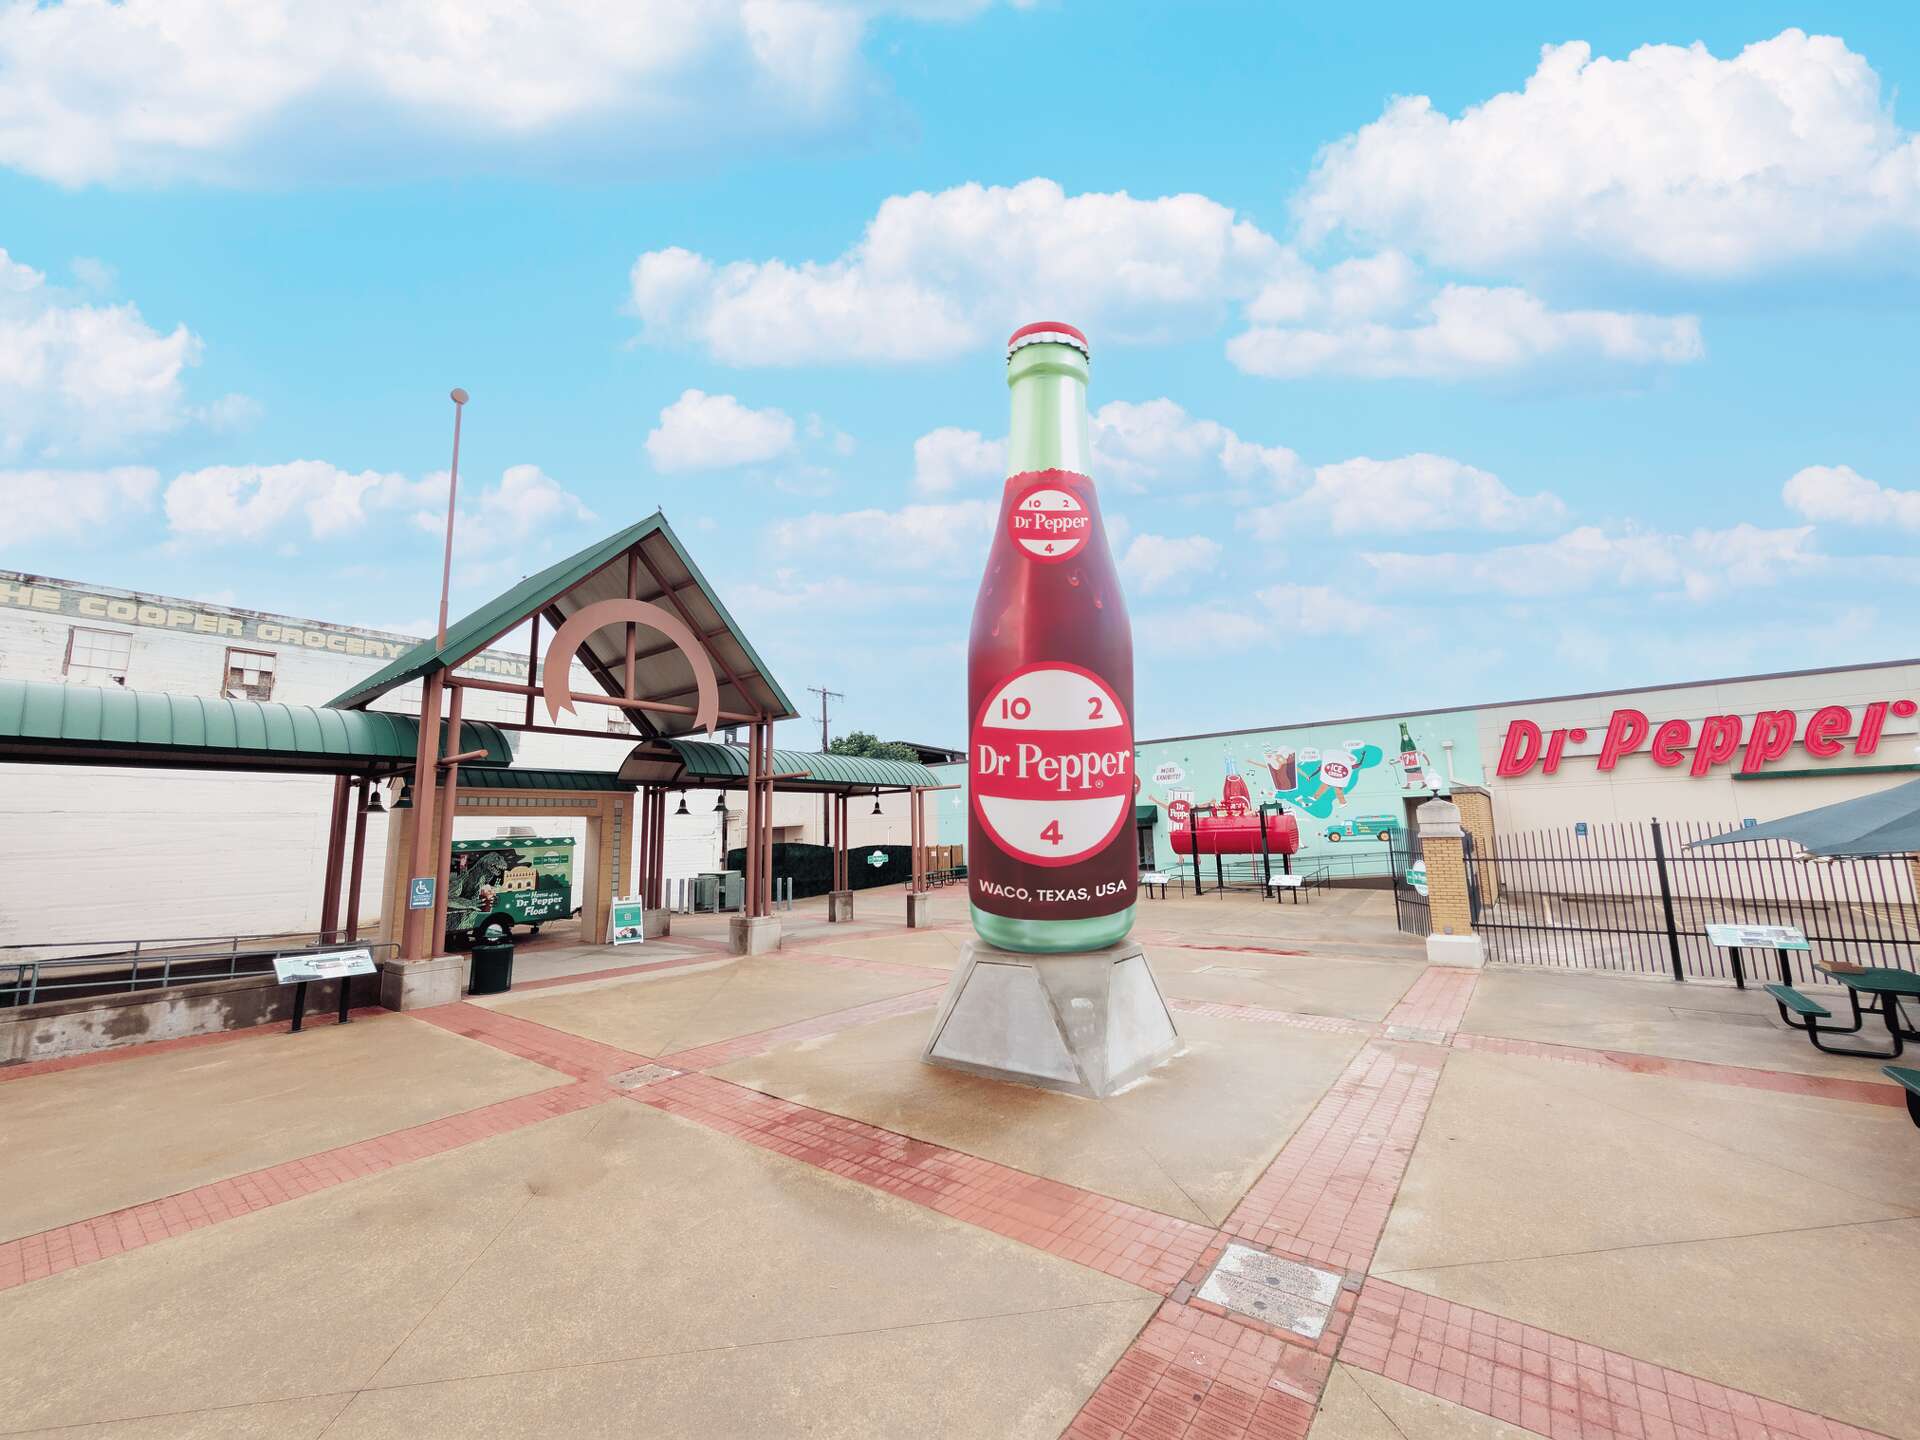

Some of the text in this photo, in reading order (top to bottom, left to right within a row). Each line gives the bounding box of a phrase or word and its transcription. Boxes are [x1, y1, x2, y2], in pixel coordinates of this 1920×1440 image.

[1028, 499, 1070, 508] 10 2
[1014, 513, 1089, 534] Dr Pepper
[1044, 543, 1054, 554] 4
[79, 597, 243, 636] COOPER
[257, 624, 405, 658] GROCERY
[1001, 696, 1104, 720] 10 2
[1496, 699, 1919, 778] Dr Pepper
[977, 743, 1131, 792] Dr Pepper
[1330, 763, 1343, 773] ICE
[1169, 808, 1190, 820] Peppe
[1176, 803, 1185, 811] Dr
[1039, 819, 1064, 846] 4
[978, 879, 1128, 903] WACO, TEXAS, USA
[516, 897, 564, 907] Dr Pepper
[524, 906, 549, 916] Float
